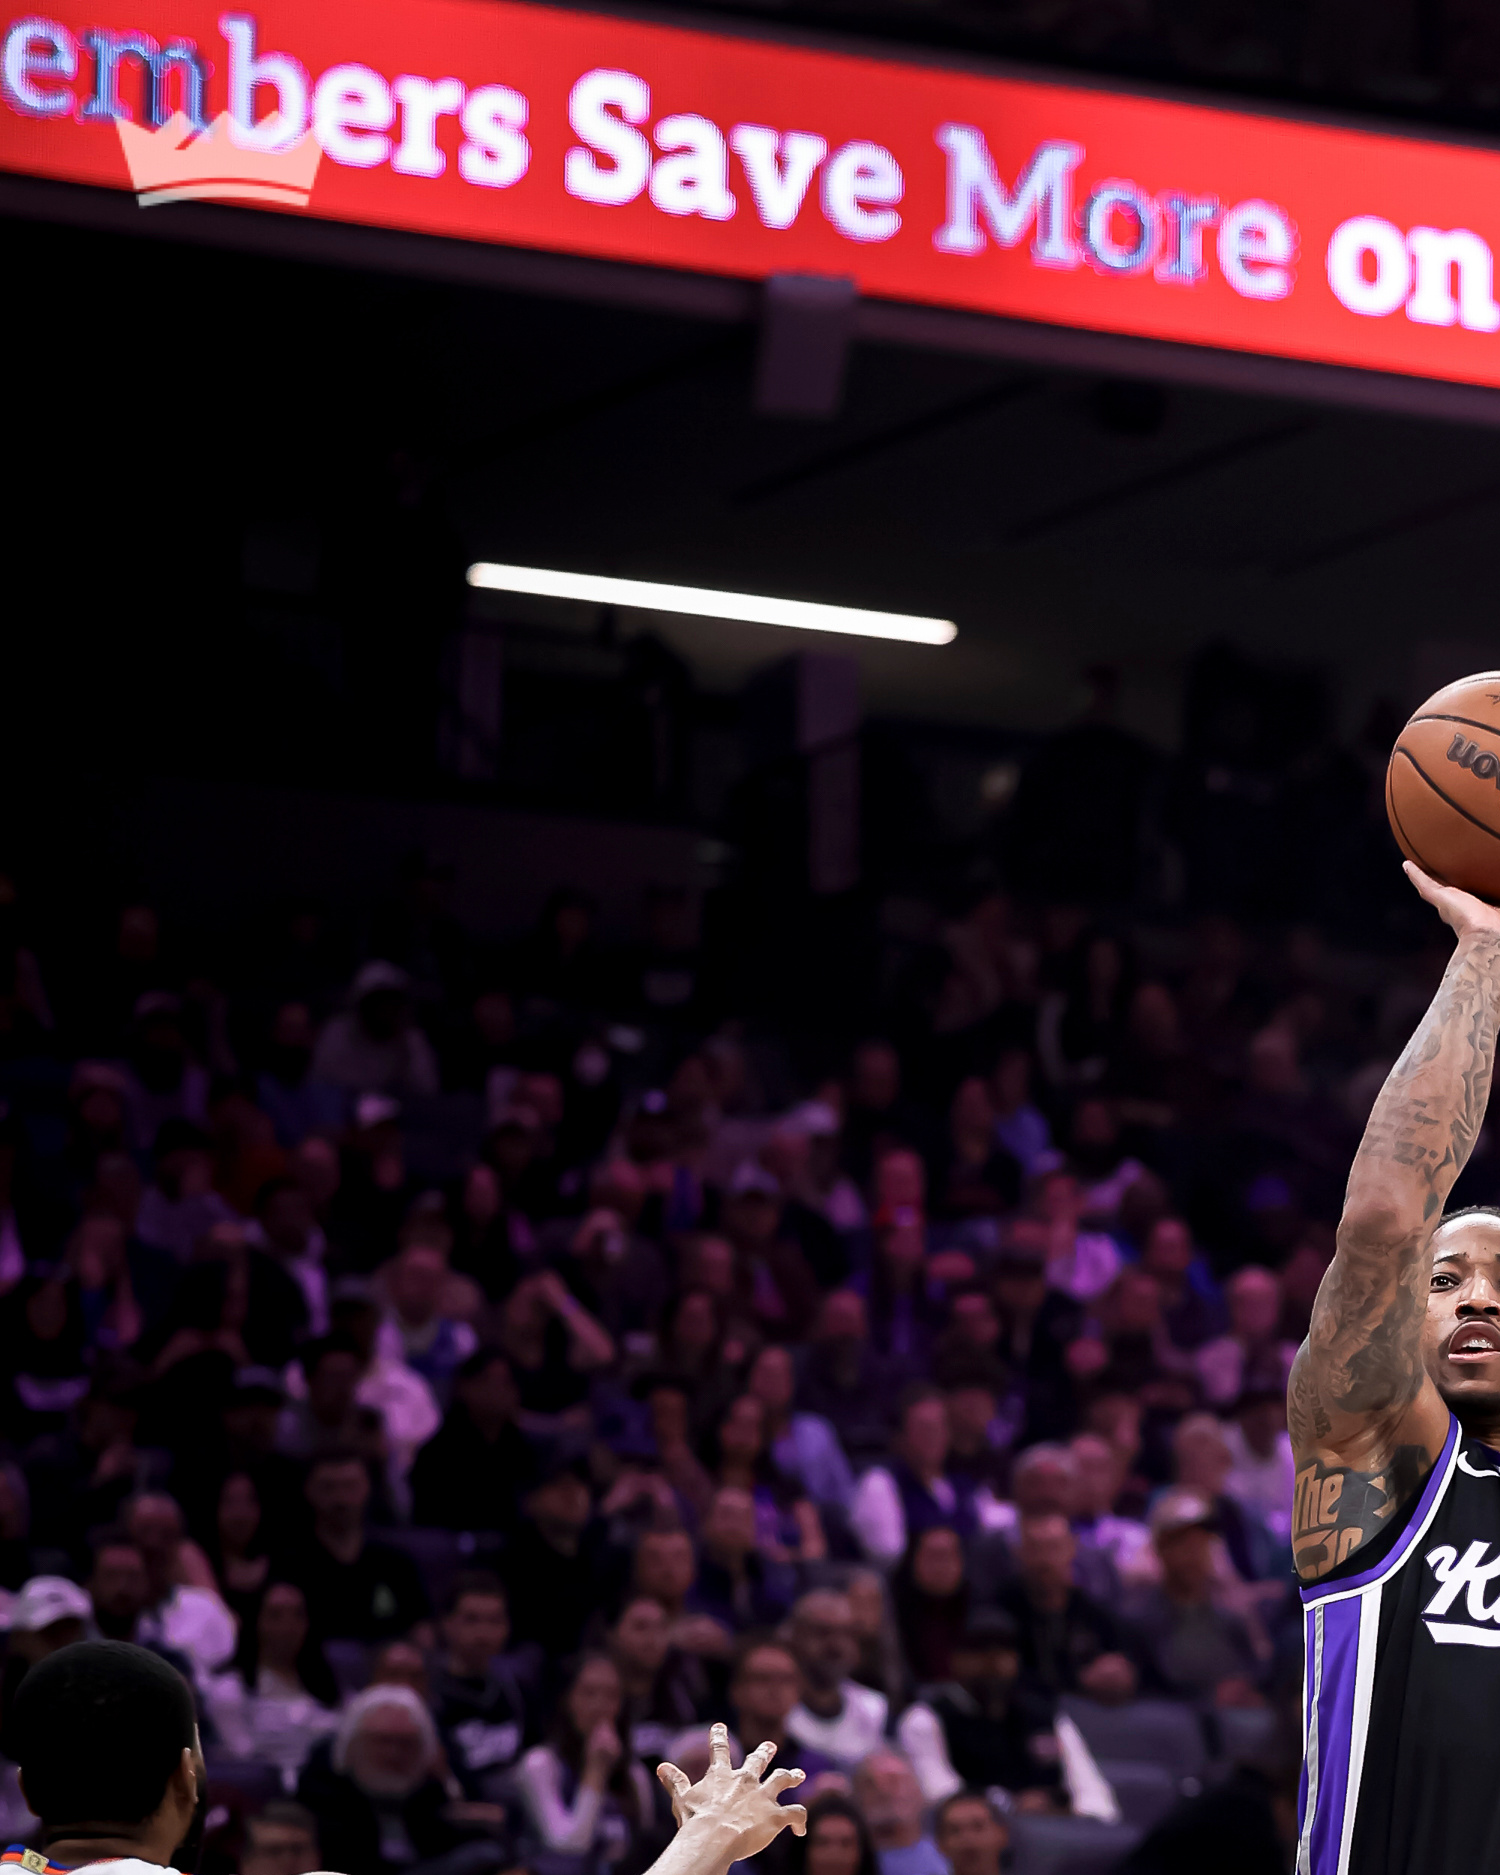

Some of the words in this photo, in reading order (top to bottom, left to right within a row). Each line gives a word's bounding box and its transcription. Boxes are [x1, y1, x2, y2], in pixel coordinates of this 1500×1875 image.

[2, 15, 531, 189] embers
[565, 68, 905, 242] Save
[934, 122, 1298, 302] More
